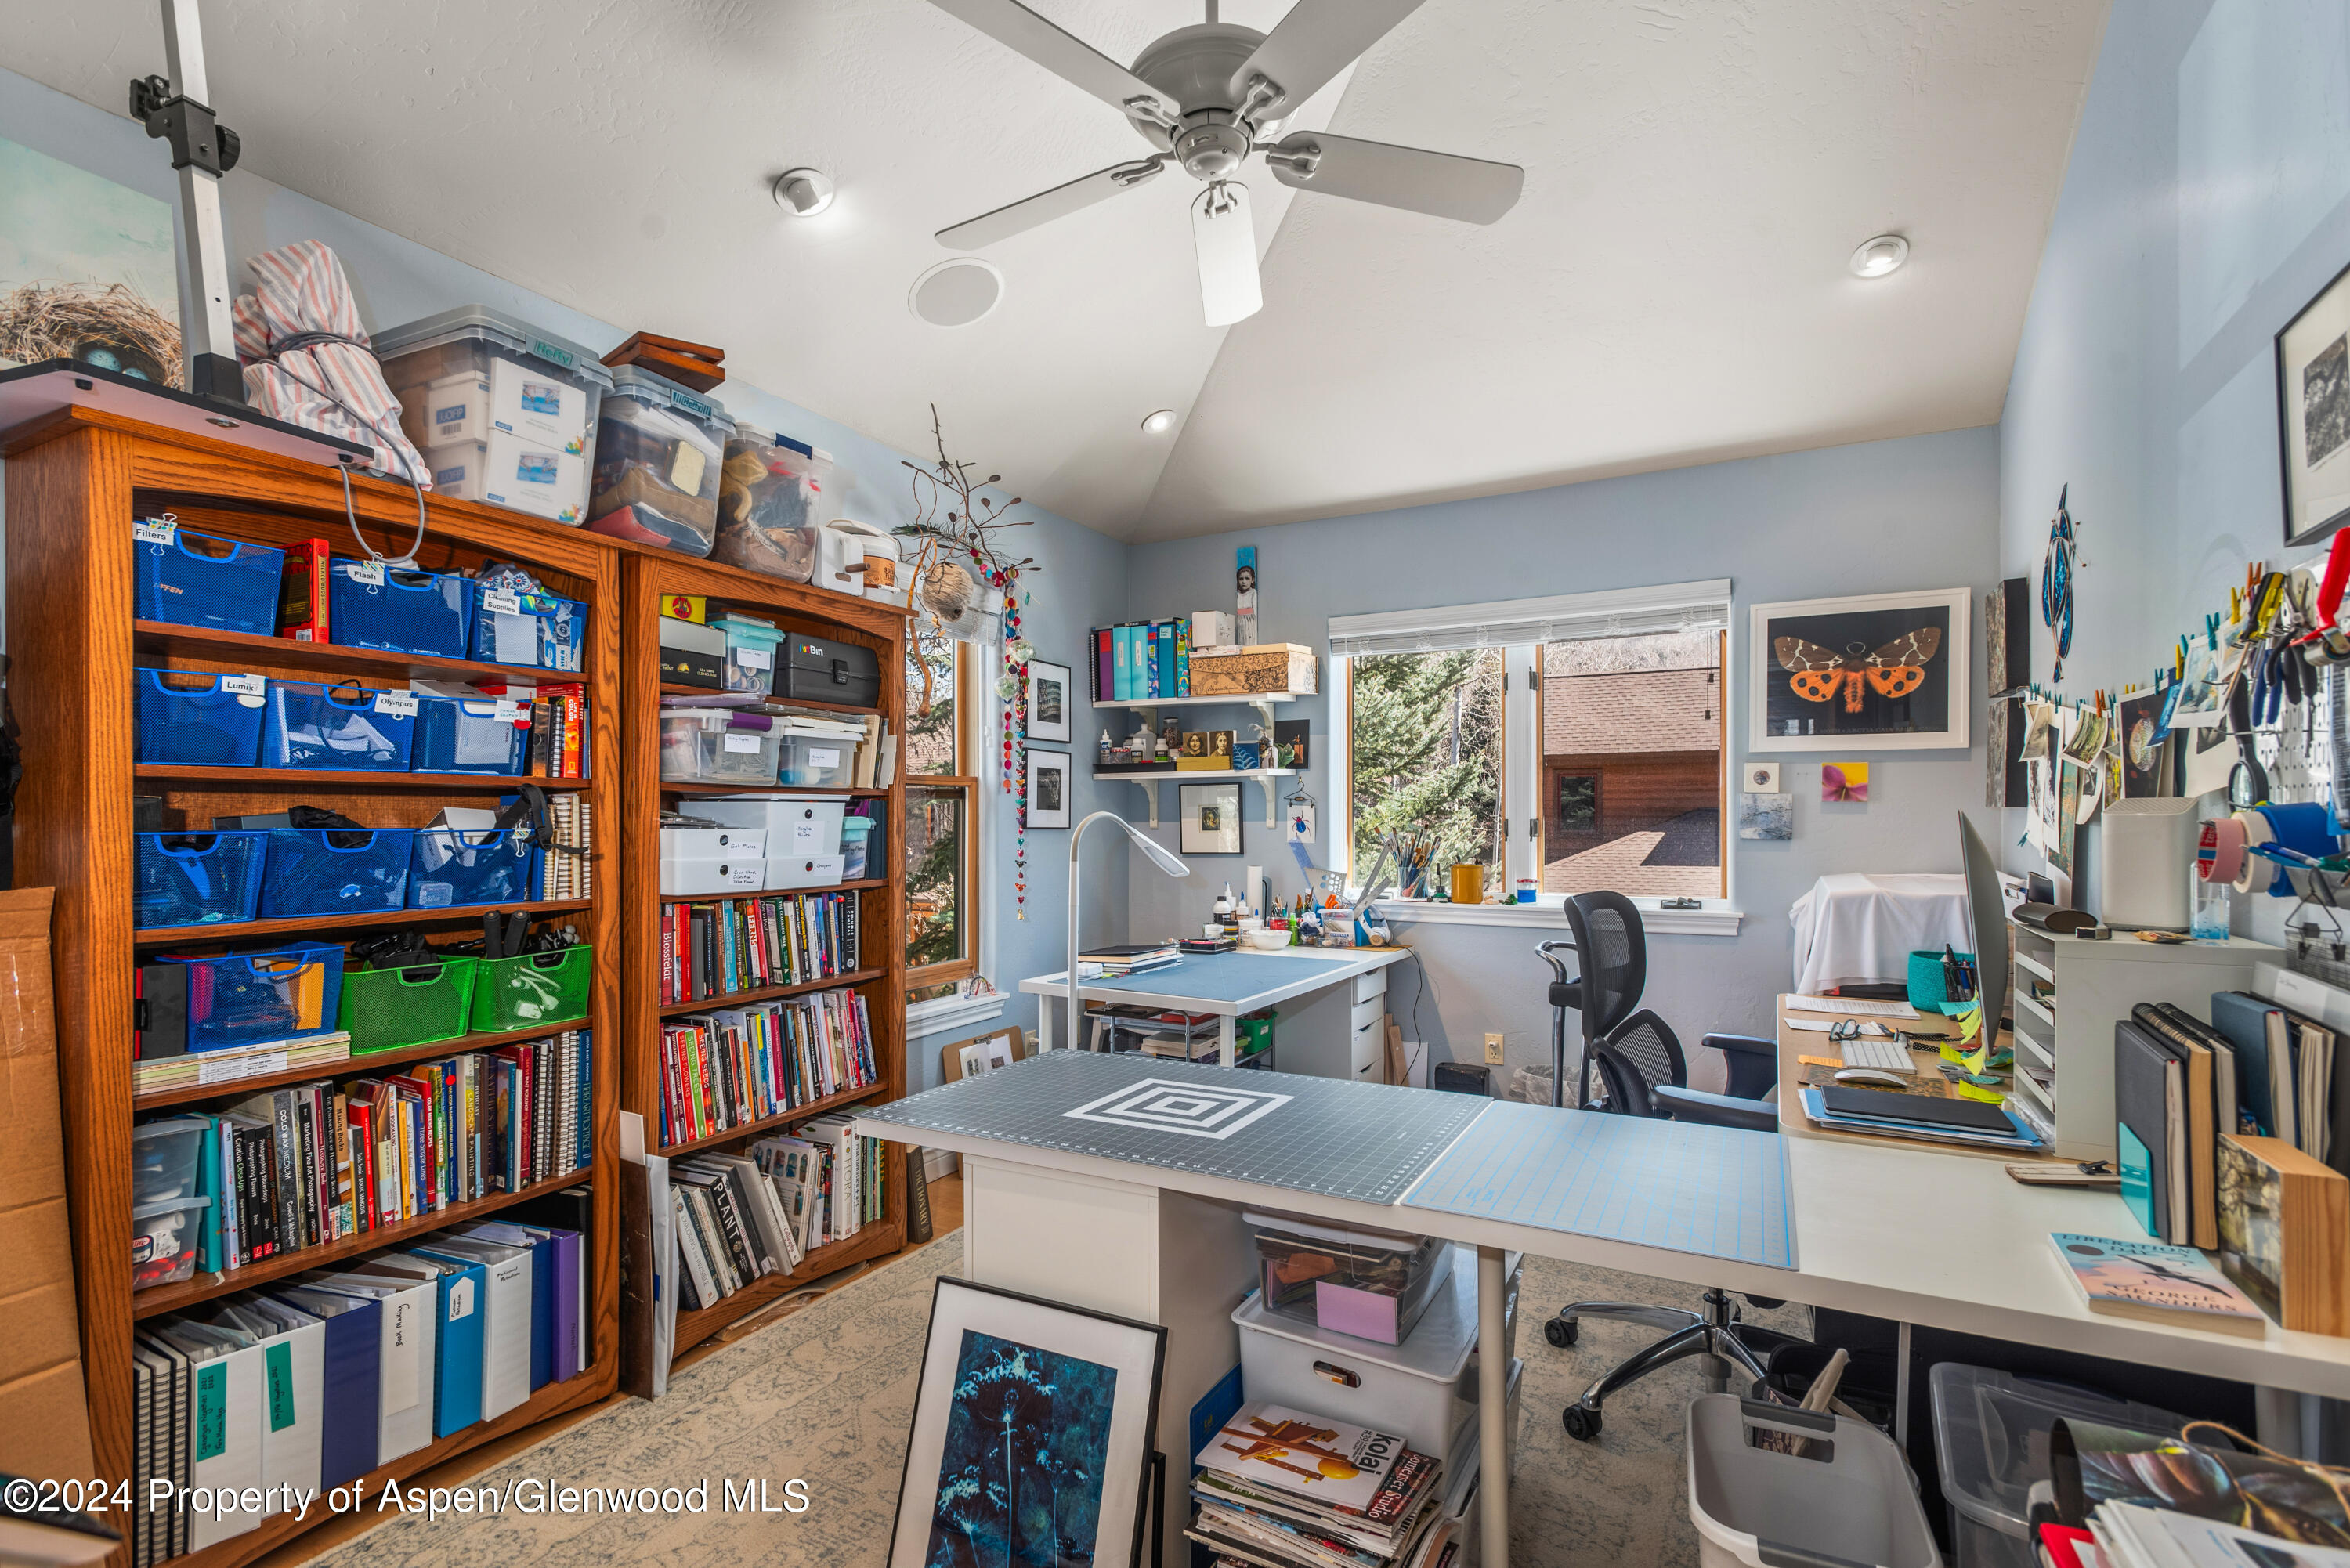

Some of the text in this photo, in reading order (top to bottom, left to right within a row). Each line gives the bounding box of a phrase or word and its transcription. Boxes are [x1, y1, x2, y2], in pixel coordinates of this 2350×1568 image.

[537, 341, 569, 365] Hefty
[684, 399, 702, 411] Hefty
[136, 529, 167, 540] Filters
[354, 571, 376, 580] Flash
[487, 602, 515, 612] Supplies
[798, 643, 823, 656] ArtBin
[227, 681, 255, 691] Lumix
[381, 698, 414, 708] Olympus
[748, 916, 757, 946] FERNS
[663, 932, 672, 981] Blossfeldt
[688, 1035, 700, 1094] SEEING TREES
[682, 1062, 691, 1097] FLOWERS
[335, 1108, 344, 1133] Making
[235, 1137, 244, 1162] Creative
[303, 1122, 312, 1152] Marketing
[248, 1142, 257, 1178] Photographing
[258, 1139, 267, 1175] Photographing
[283, 1149, 291, 1180] MEDIUM
[237, 1162, 245, 1192] Close-Ups
[844, 1158, 852, 1201] FLORA
[306, 1175, 316, 1212] Photography
[915, 1168, 927, 1224] DICTIONARY
[714, 1181, 740, 1240] PLANT
[681, 1215, 696, 1250] EXPLORING
[695, 1258, 710, 1285] INVISIBLE
[783, 1227, 796, 1253] Calligraphy
[2063, 1234, 2192, 1254] LIBERATION
[2110, 1246, 2148, 1255] DAY
[2106, 1290, 2237, 1311] SAUNDERS
[2113, 1285, 2216, 1302] GEORGE
[396, 1303, 410, 1347] Book Making
[1360, 1429, 1373, 1442] #39
[1350, 1433, 1401, 1476] kolaj
[1390, 1454, 1429, 1490] Somerset
[1368, 1490, 1402, 1519] Studio
